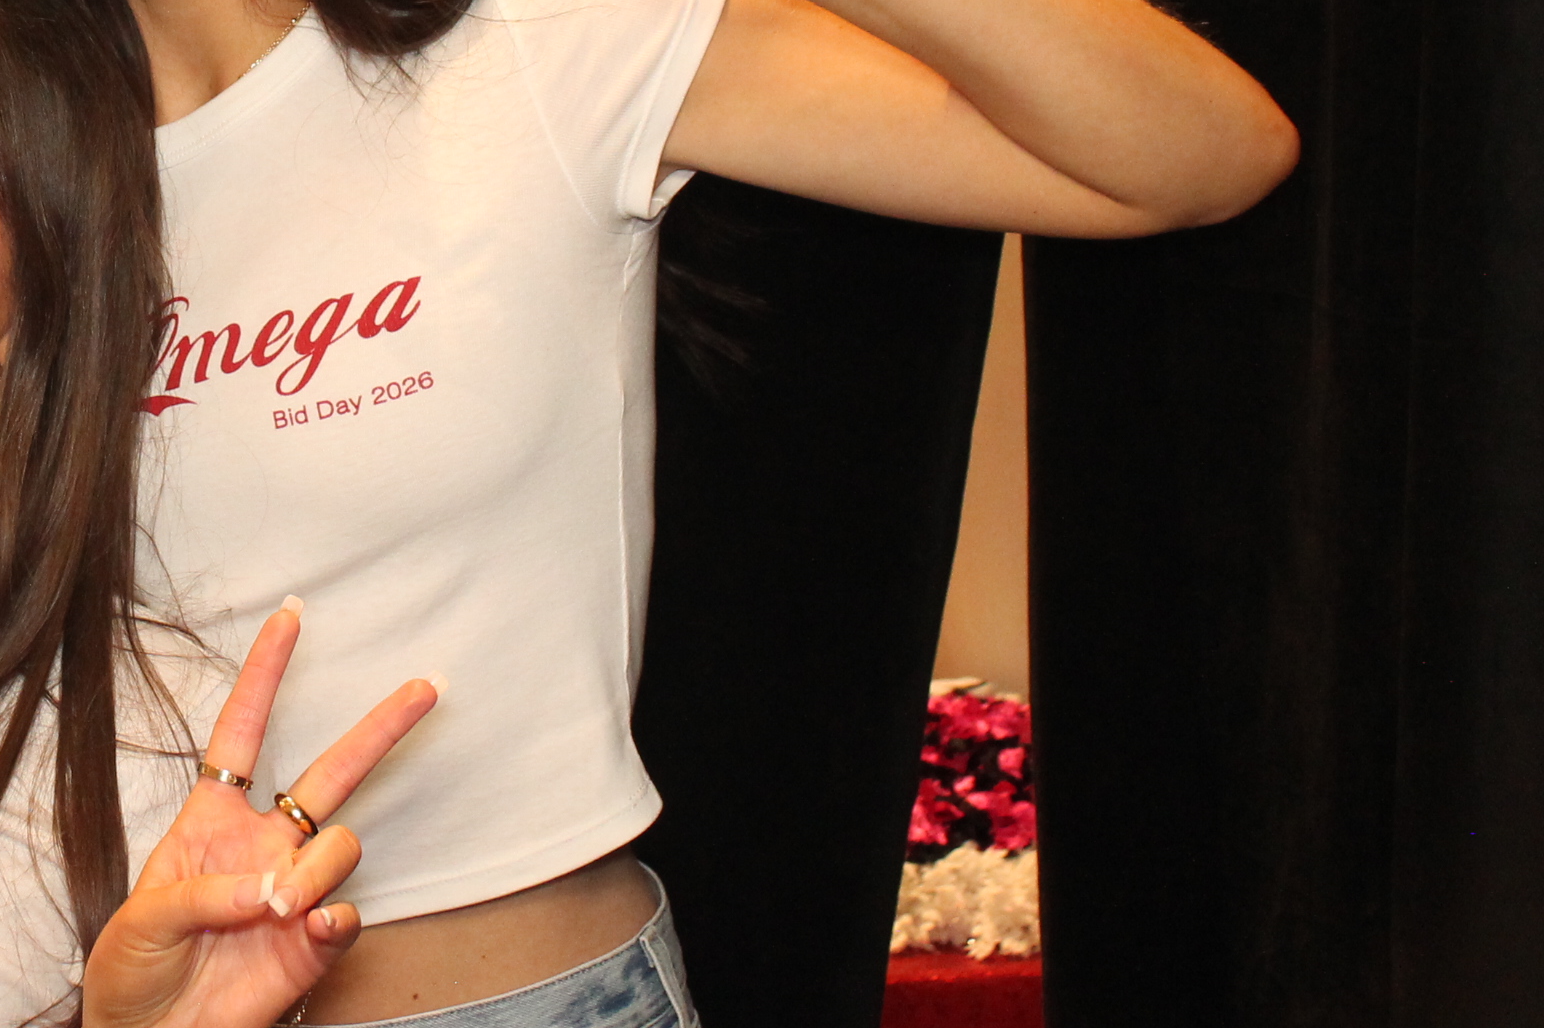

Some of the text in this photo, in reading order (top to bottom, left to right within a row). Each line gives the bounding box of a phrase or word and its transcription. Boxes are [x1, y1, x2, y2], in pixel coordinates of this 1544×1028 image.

[273, 371, 435, 430] Bid Day 2026
